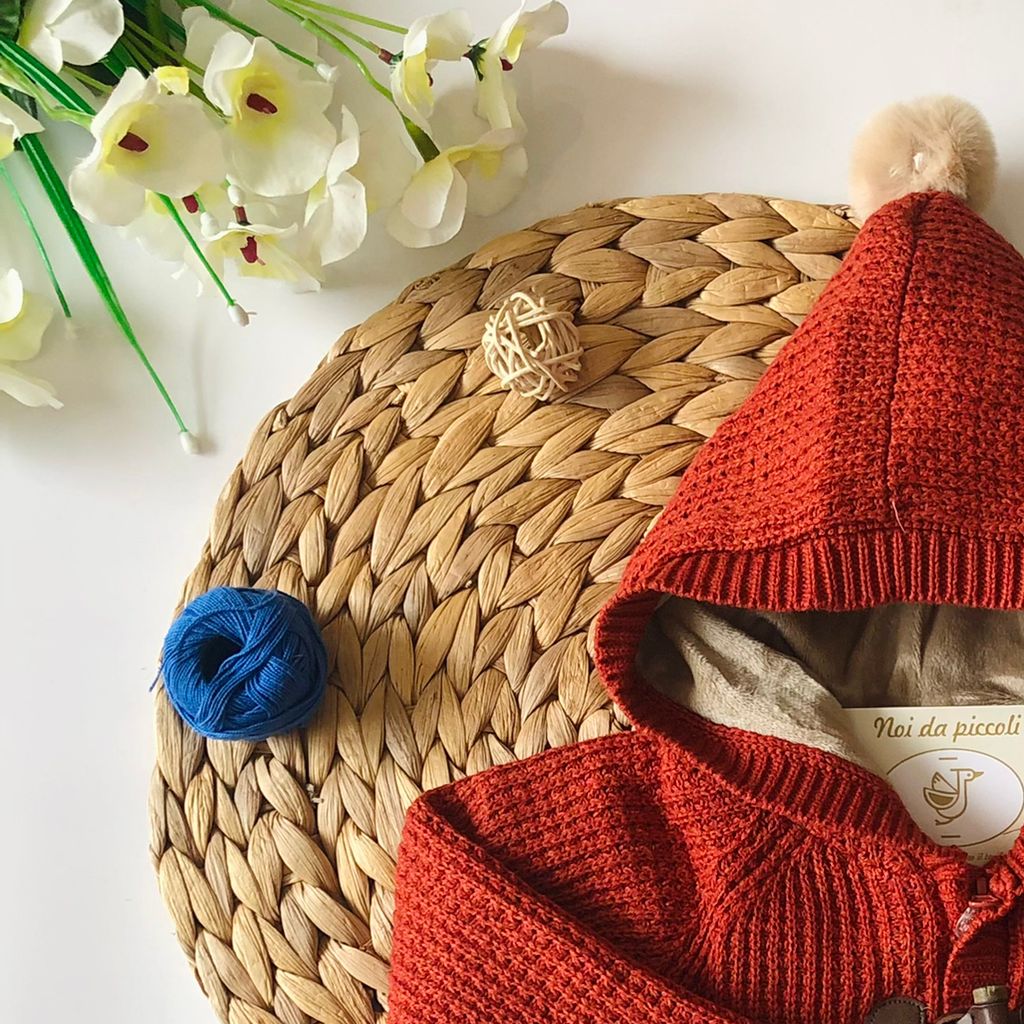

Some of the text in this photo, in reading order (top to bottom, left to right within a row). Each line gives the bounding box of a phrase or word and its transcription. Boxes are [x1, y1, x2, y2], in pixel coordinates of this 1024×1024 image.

[873, 714, 1022, 743] Noi da piccoli
